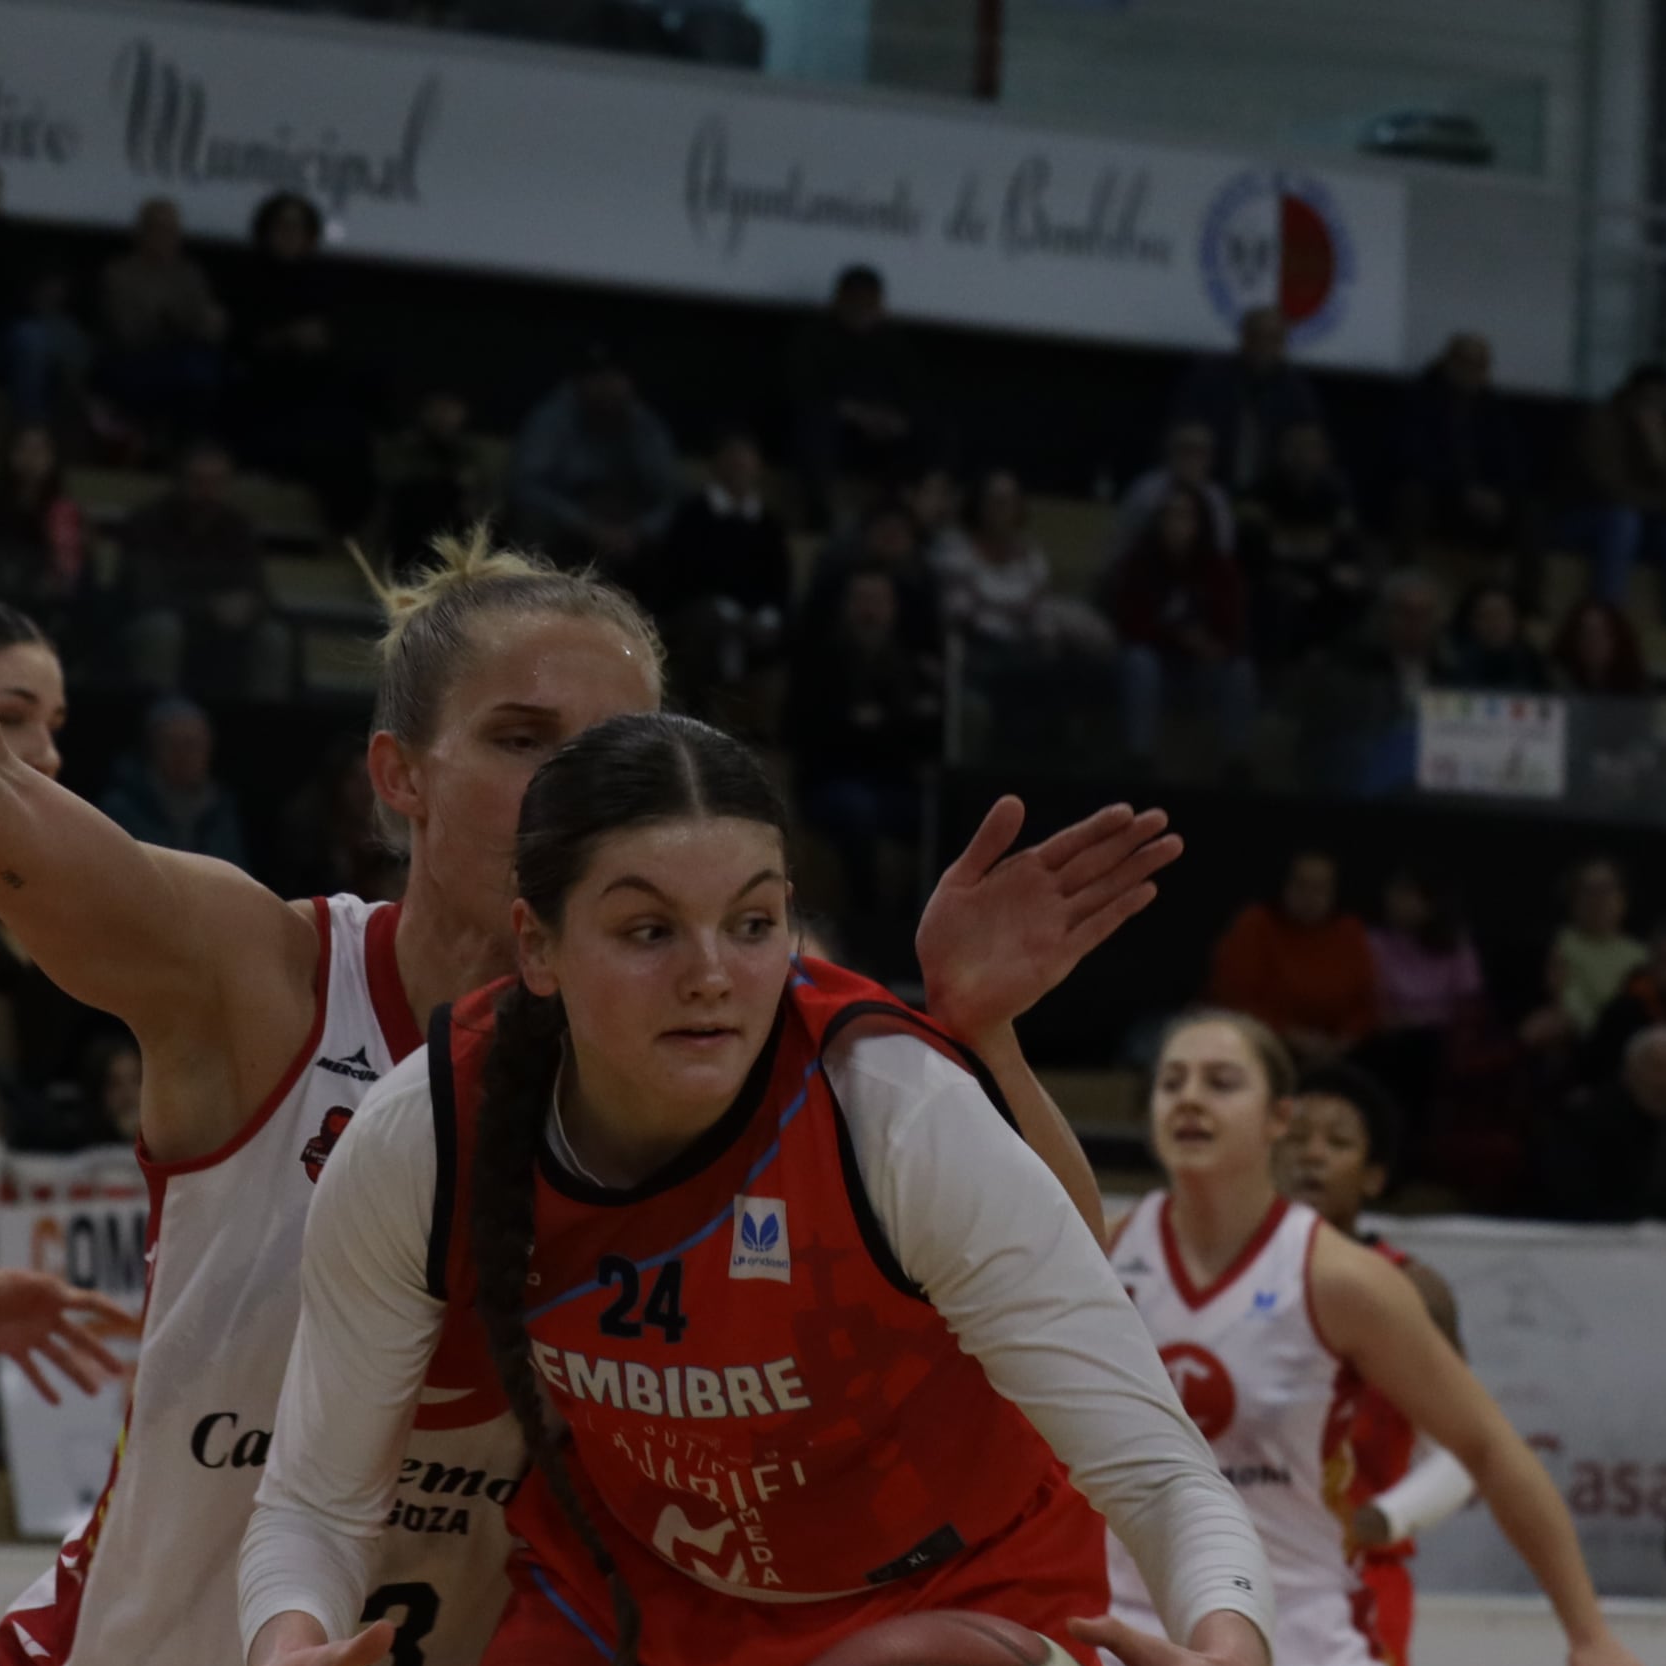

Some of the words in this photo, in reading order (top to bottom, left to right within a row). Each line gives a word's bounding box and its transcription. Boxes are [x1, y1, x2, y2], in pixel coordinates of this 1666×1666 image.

[316, 1057, 381, 1082] MERCUR
[597, 1254, 689, 1344] 24
[527, 1337, 813, 1419] EMBIBRE
